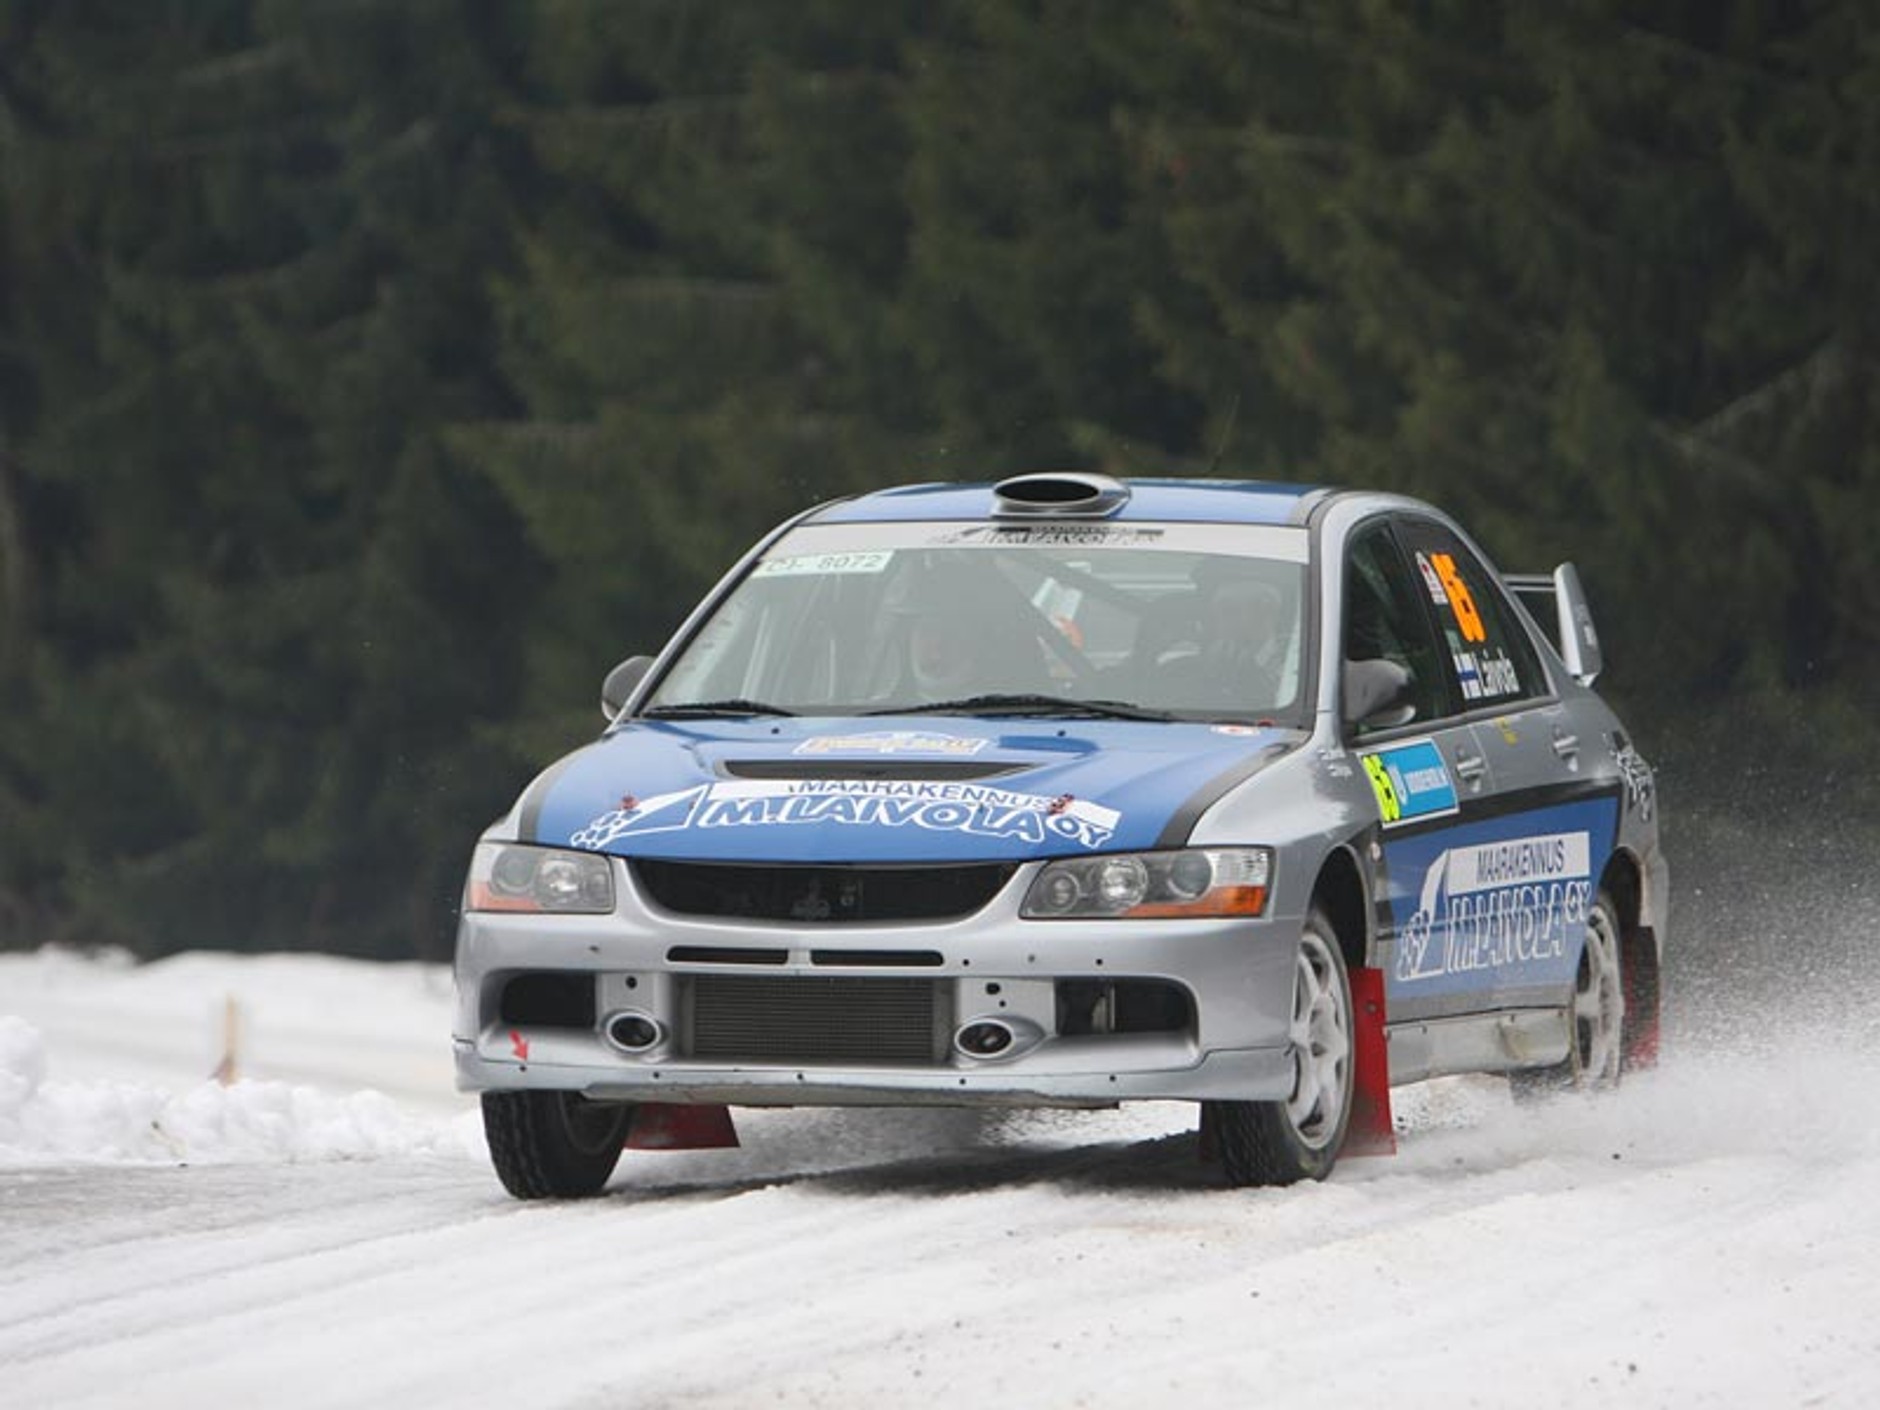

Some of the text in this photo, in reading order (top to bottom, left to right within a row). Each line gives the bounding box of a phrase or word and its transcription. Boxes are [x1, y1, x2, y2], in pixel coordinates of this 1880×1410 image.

[817, 554, 883, 570] 8072
[800, 781, 1049, 811] MAARAKENNUS
[698, 796, 1113, 849] M.LAIVOLA OY
[1476, 839, 1565, 884] MAARAKENNUS
